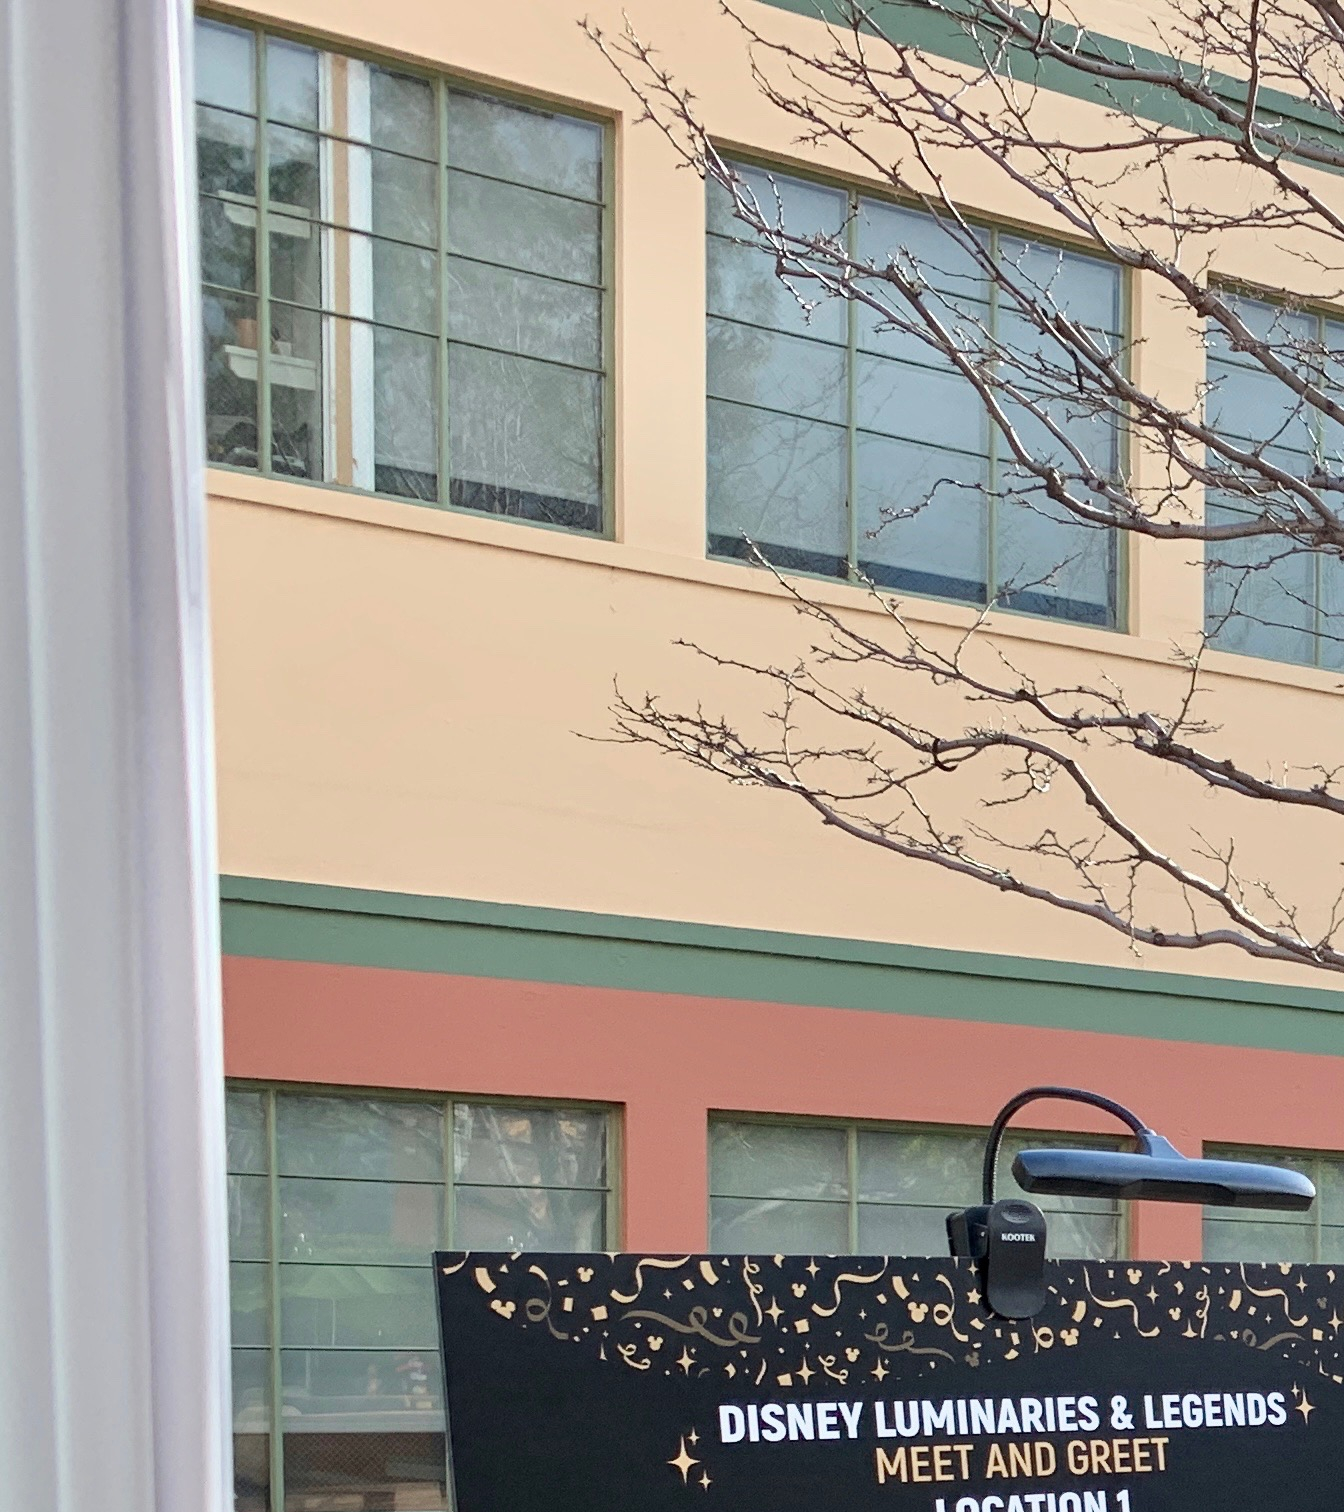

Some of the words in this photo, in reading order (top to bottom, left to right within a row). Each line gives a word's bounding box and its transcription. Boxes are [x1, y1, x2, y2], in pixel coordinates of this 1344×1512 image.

[718, 1401, 864, 1445] DISNEY
[875, 1395, 1101, 1439] LUMINARIES
[1110, 1394, 1136, 1431] &
[1143, 1391, 1287, 1431] LEGENDS
[875, 1443, 975, 1485] MEET
[985, 1439, 1059, 1479] AND
[1067, 1437, 1170, 1477] GREET
